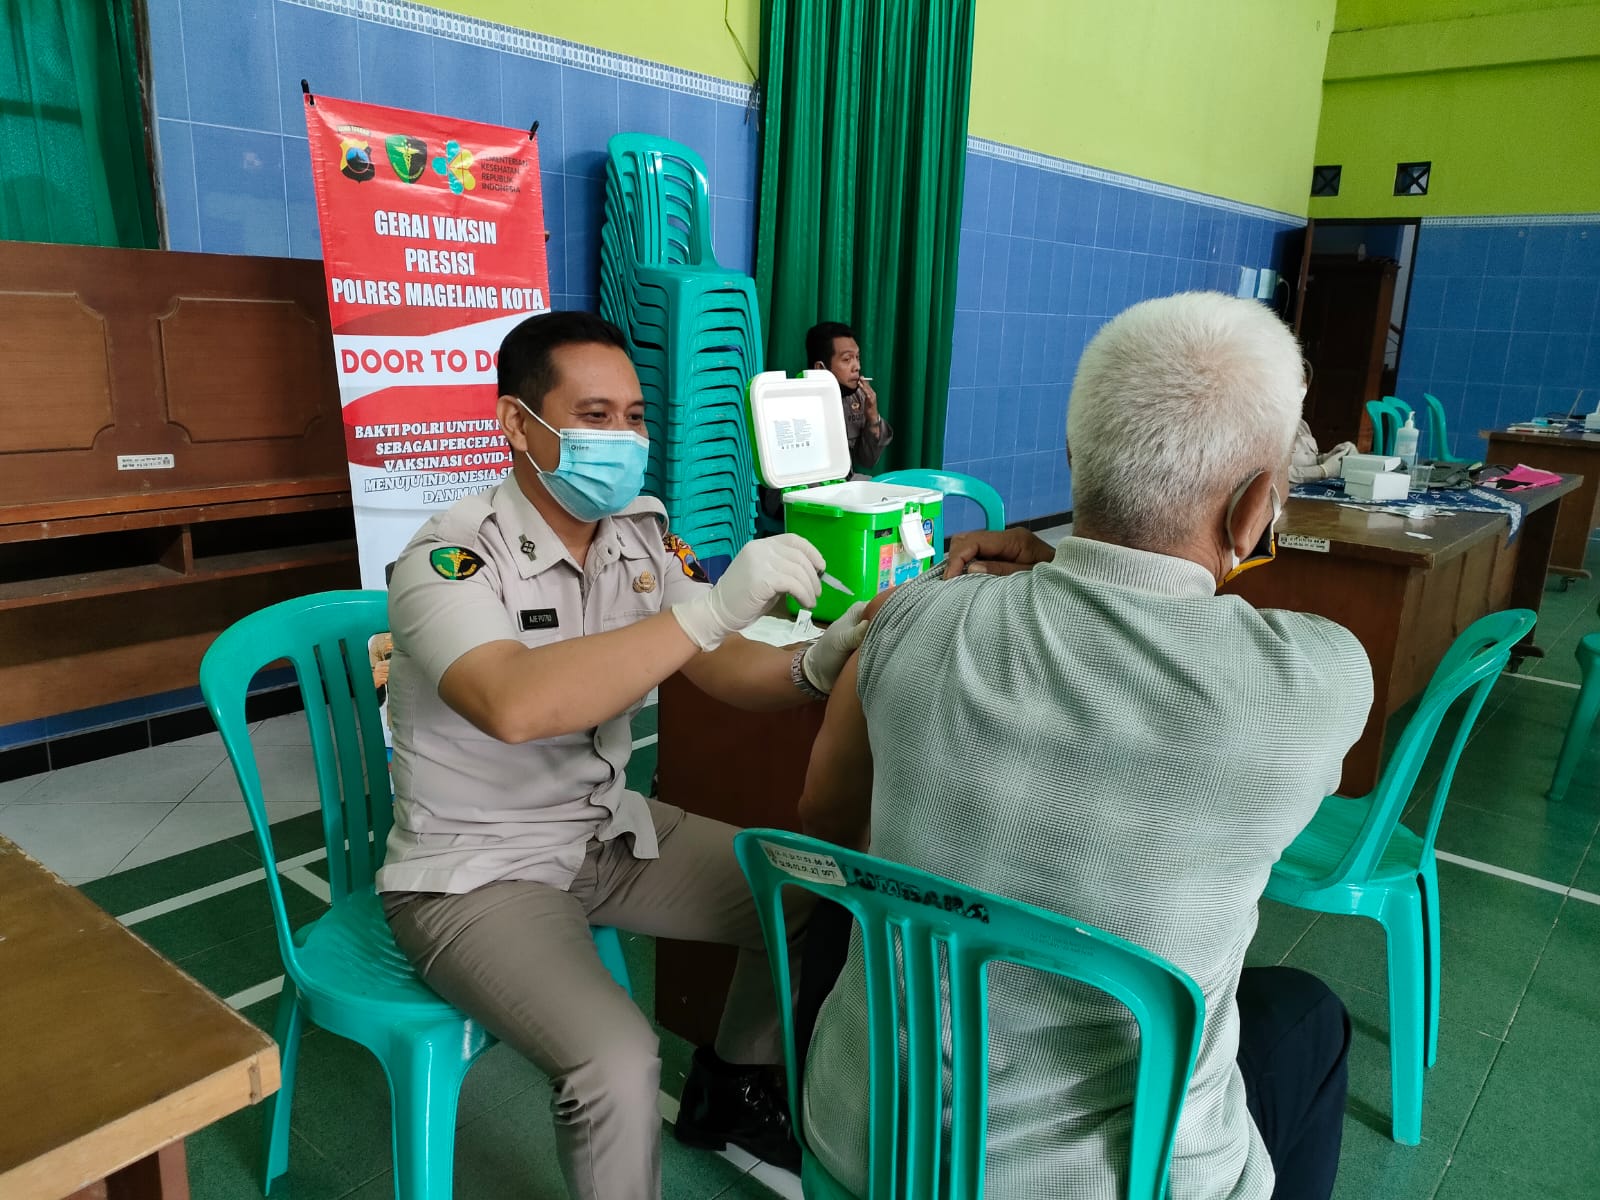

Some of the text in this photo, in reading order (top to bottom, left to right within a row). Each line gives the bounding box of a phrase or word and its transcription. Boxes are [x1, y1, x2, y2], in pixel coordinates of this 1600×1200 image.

[374, 209, 497, 245] GERAI VAKSIN
[404, 248, 475, 276] PRESISI
[331, 277, 545, 311] POLRES MAGELANG KOTA
[341, 348, 424, 375] DOOR
[430, 348, 468, 374] TO
[354, 423, 400, 440] BAKTI
[401, 420, 445, 436] POLRI
[445, 419, 494, 435] UNTUK
[375, 434, 510, 456] SEBAGAI PERCEPAT
[383, 454, 463, 473] VAKSINASI
[364, 473, 420, 493] MENUJU
[421, 467, 498, 487] INDONESIA
[422, 488, 457, 504] DAN
